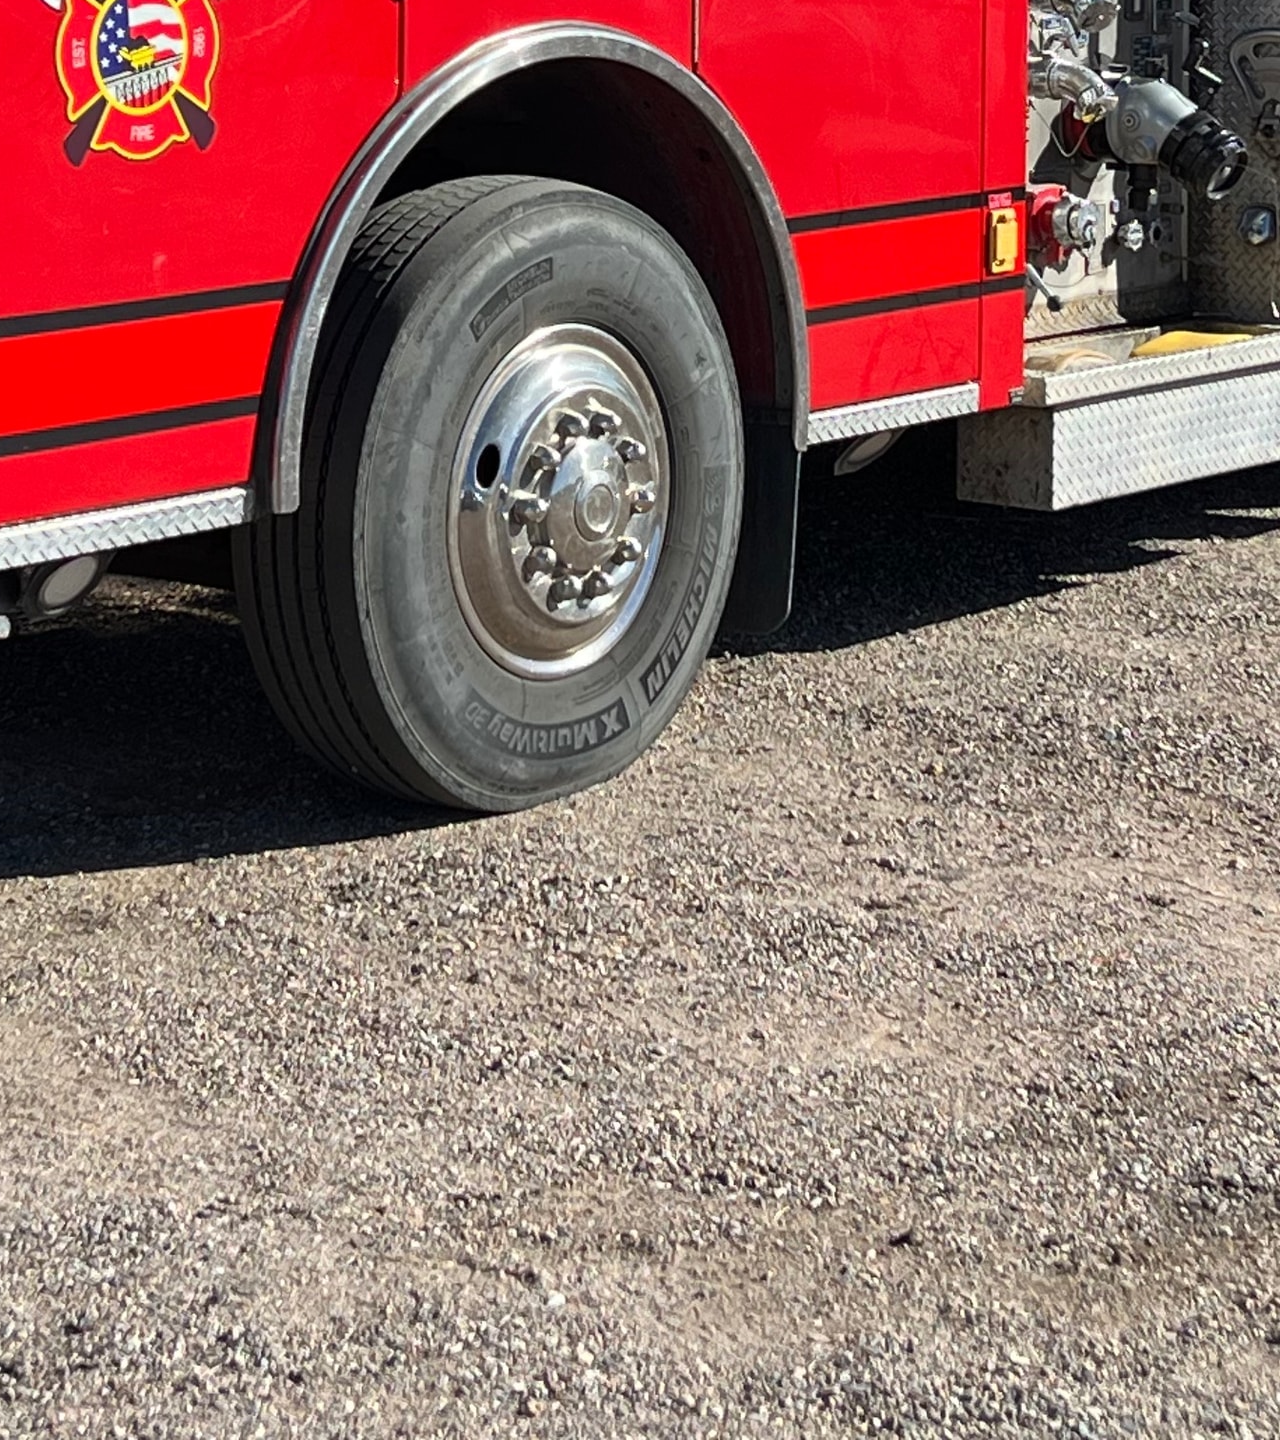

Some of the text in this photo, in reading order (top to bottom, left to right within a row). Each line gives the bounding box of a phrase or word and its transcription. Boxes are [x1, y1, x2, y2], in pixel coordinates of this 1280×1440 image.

[129, 124, 156, 142] FIRE
[646, 522, 719, 701] MICHELIN
[600, 705, 623, 739] X
